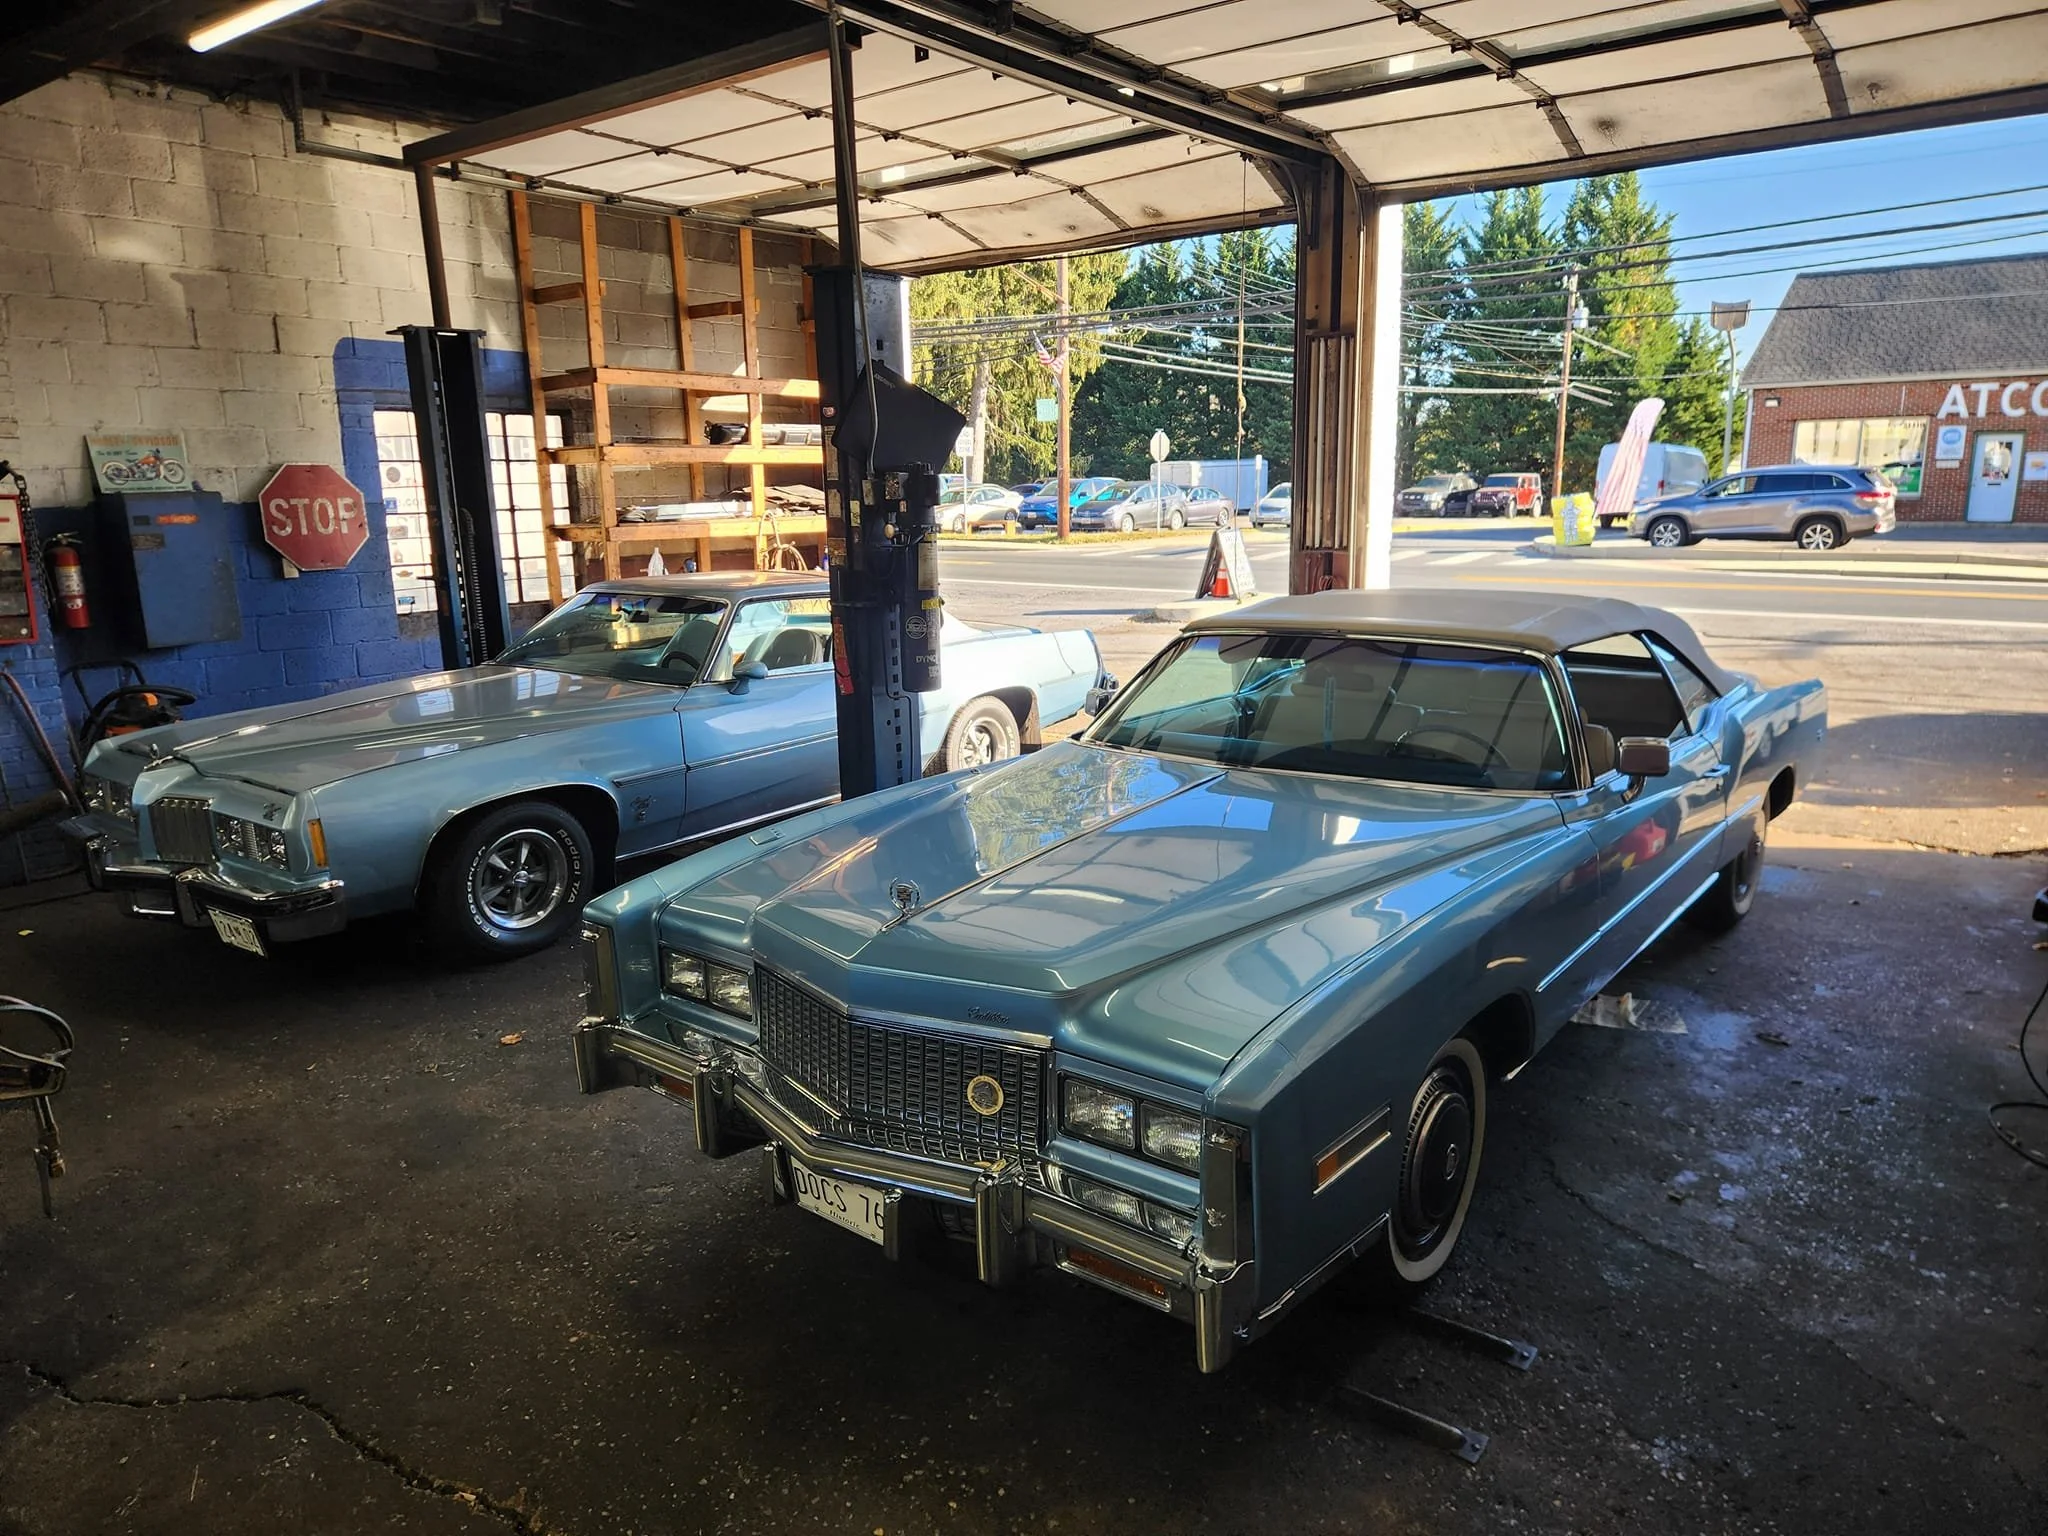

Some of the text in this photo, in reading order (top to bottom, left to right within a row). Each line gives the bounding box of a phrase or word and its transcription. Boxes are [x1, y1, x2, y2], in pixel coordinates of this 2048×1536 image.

[268, 497, 358, 537] STOP
[556, 828, 582, 904] Radial T/A
[793, 1166, 884, 1230] DOCS 76
[828, 1209, 861, 1228] Historic
